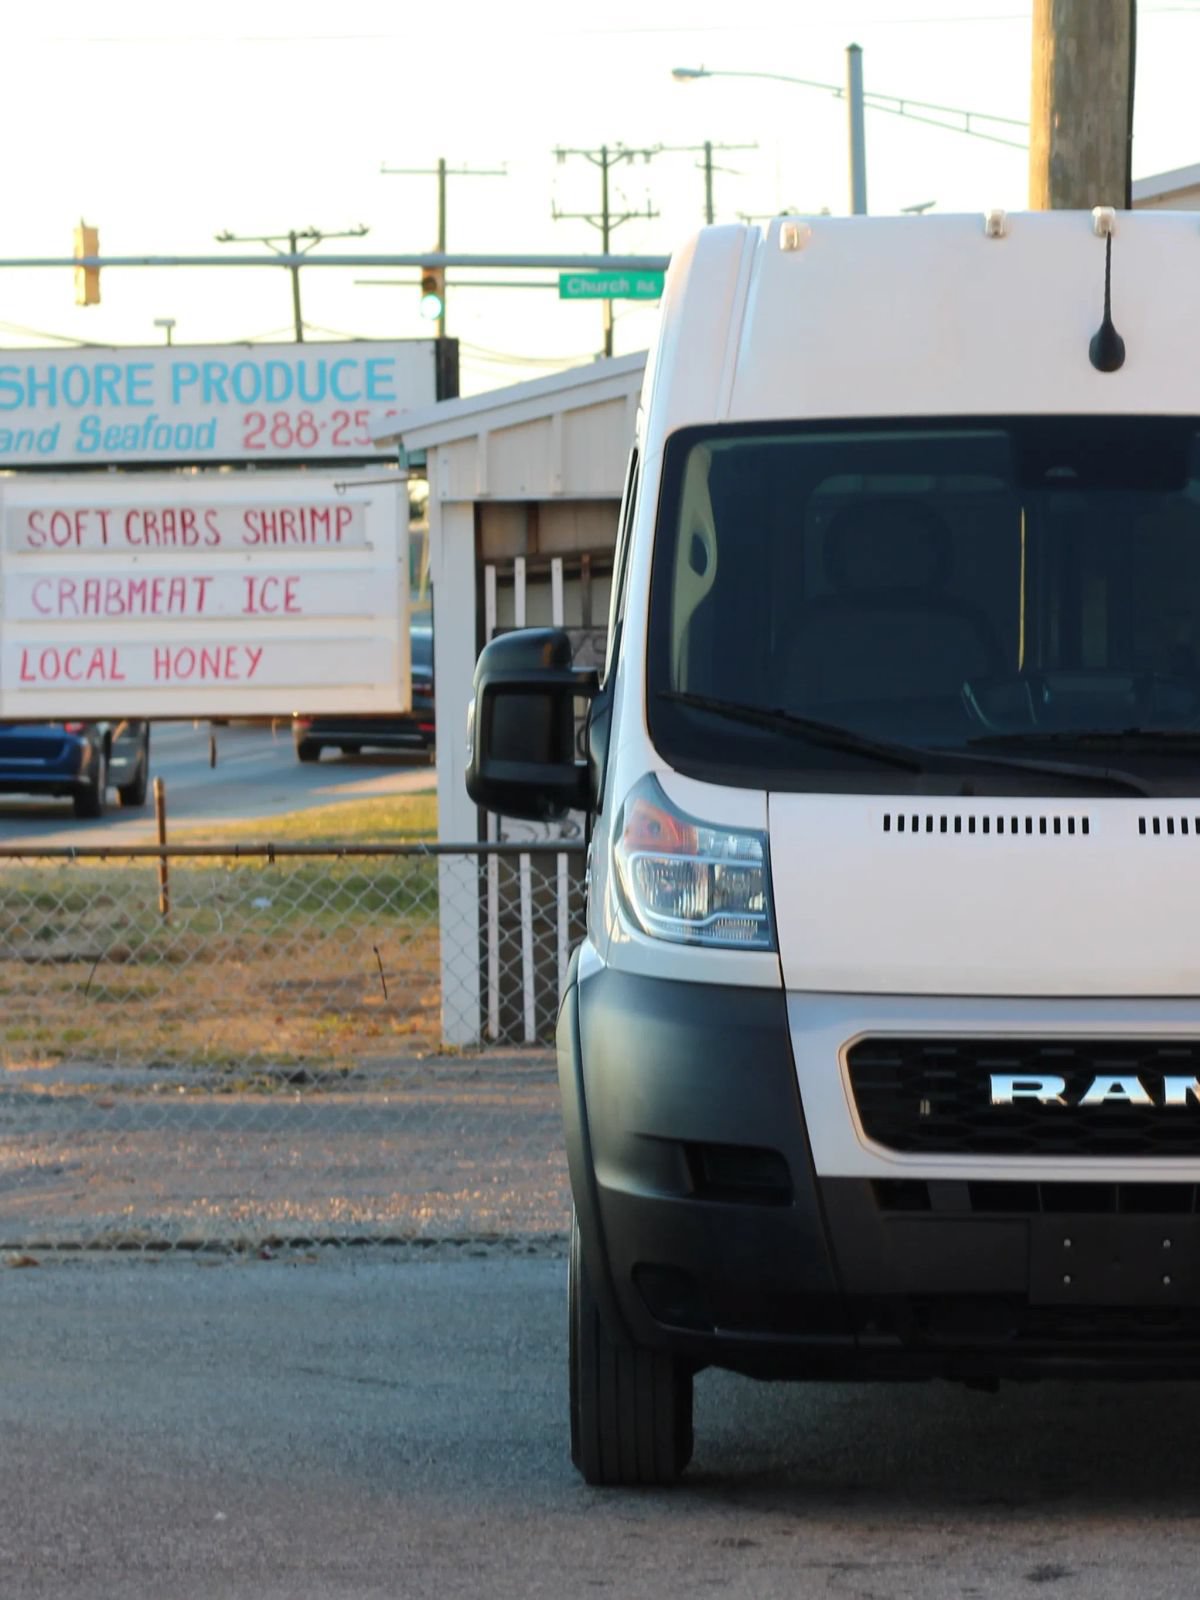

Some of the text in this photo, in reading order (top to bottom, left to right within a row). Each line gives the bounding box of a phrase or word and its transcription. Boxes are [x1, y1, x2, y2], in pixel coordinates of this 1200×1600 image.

[566, 277, 630, 294] Church
[0, 357, 397, 412] SHORE PRODUCE
[0, 421, 61, 453] and
[76, 413, 217, 453] Seafood
[26, 505, 353, 548] SOFT CRABS SHRIMP
[31, 575, 302, 616] CRABMEAT ICE
[20, 645, 263, 681] LOCAL HONEY
